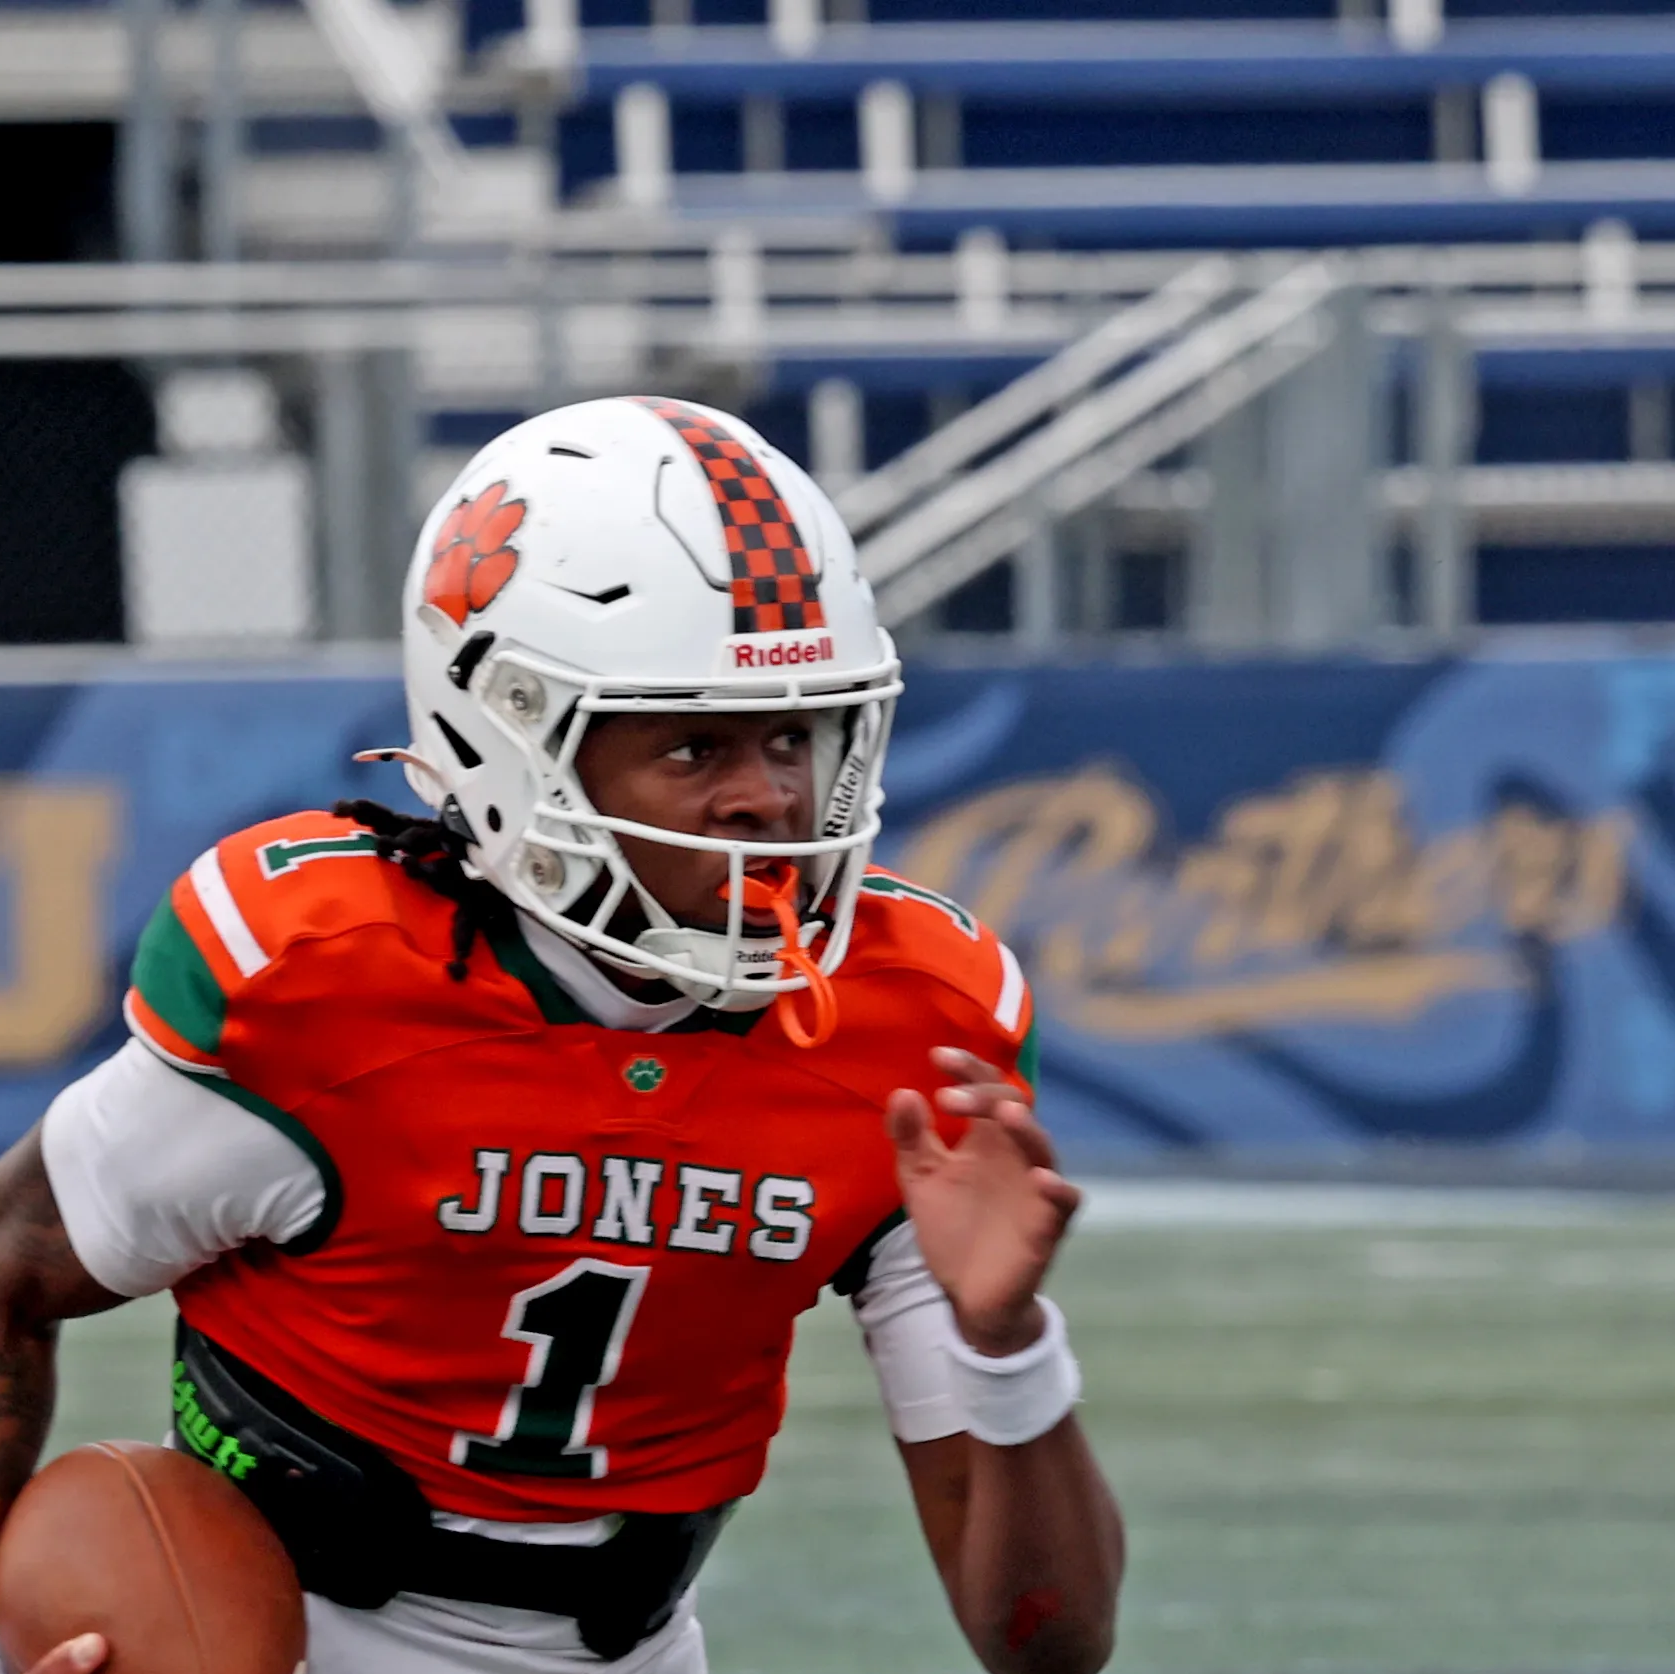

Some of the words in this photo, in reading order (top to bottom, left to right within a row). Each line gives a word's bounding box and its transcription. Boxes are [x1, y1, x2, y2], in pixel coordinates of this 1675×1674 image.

[730, 636, 834, 668] Riddell
[822, 755, 866, 838] Riddell
[437, 1148, 816, 1262] JONES
[449, 1257, 653, 1480] 1
